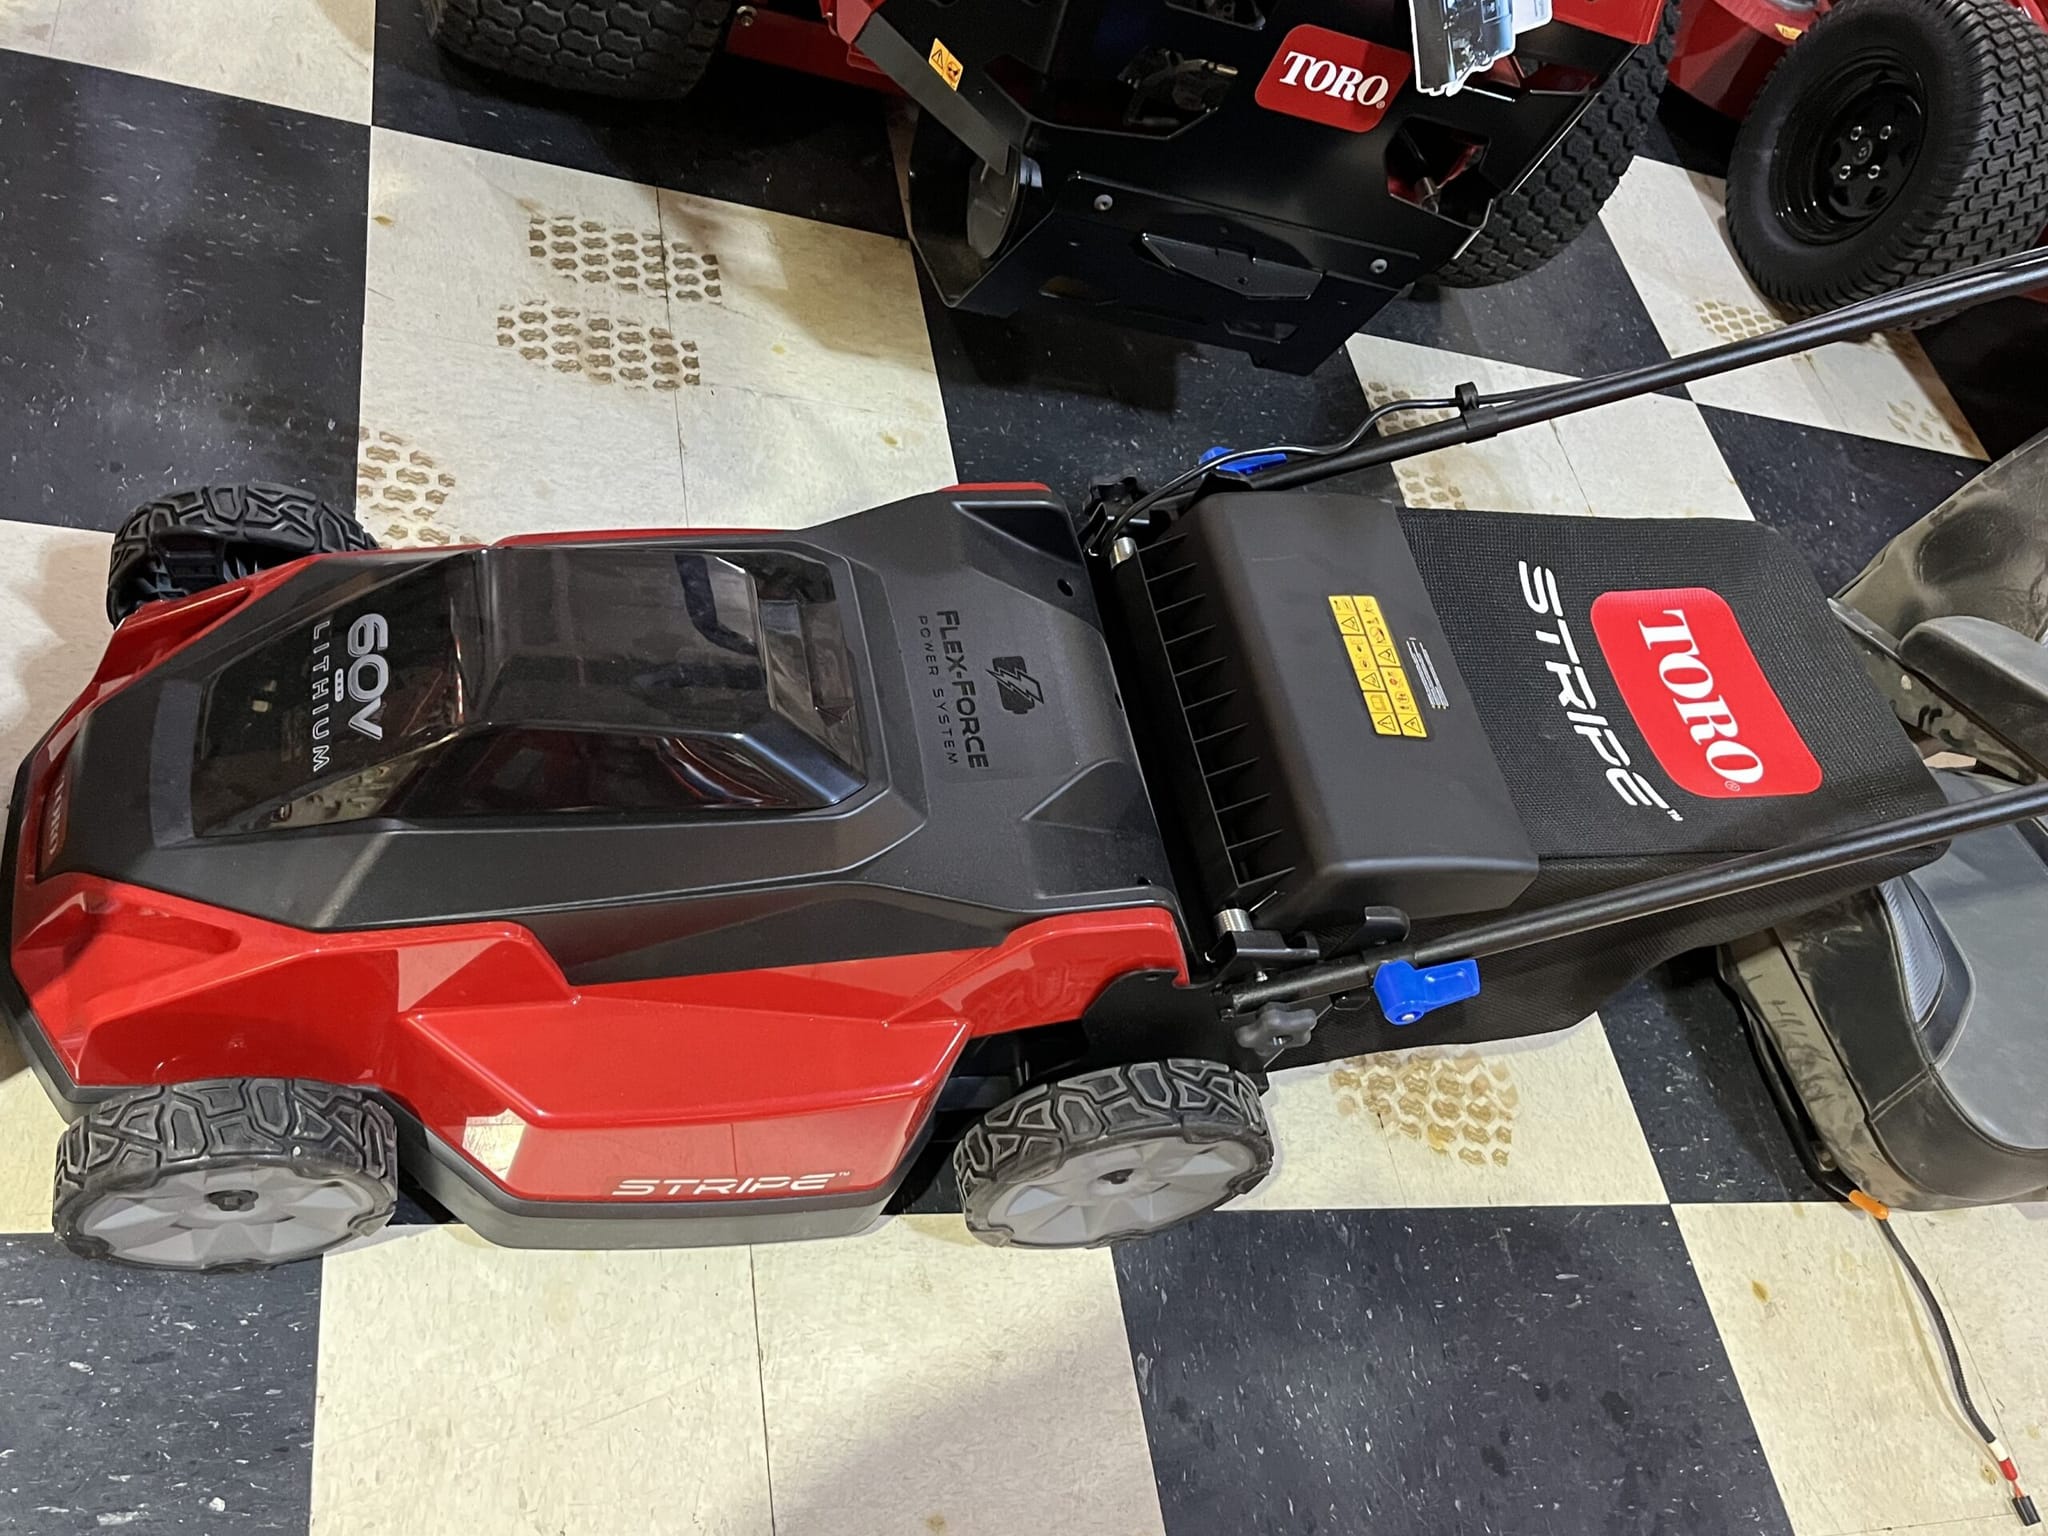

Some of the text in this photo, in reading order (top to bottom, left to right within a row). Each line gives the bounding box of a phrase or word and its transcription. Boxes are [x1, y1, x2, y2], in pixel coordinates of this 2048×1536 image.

[312, 620, 331, 772] LITHIUM
[347, 613, 389, 740] 60V
[918, 615, 958, 765] POWER SYSTEM
[936, 610, 989, 768] FLEX-FORCE
